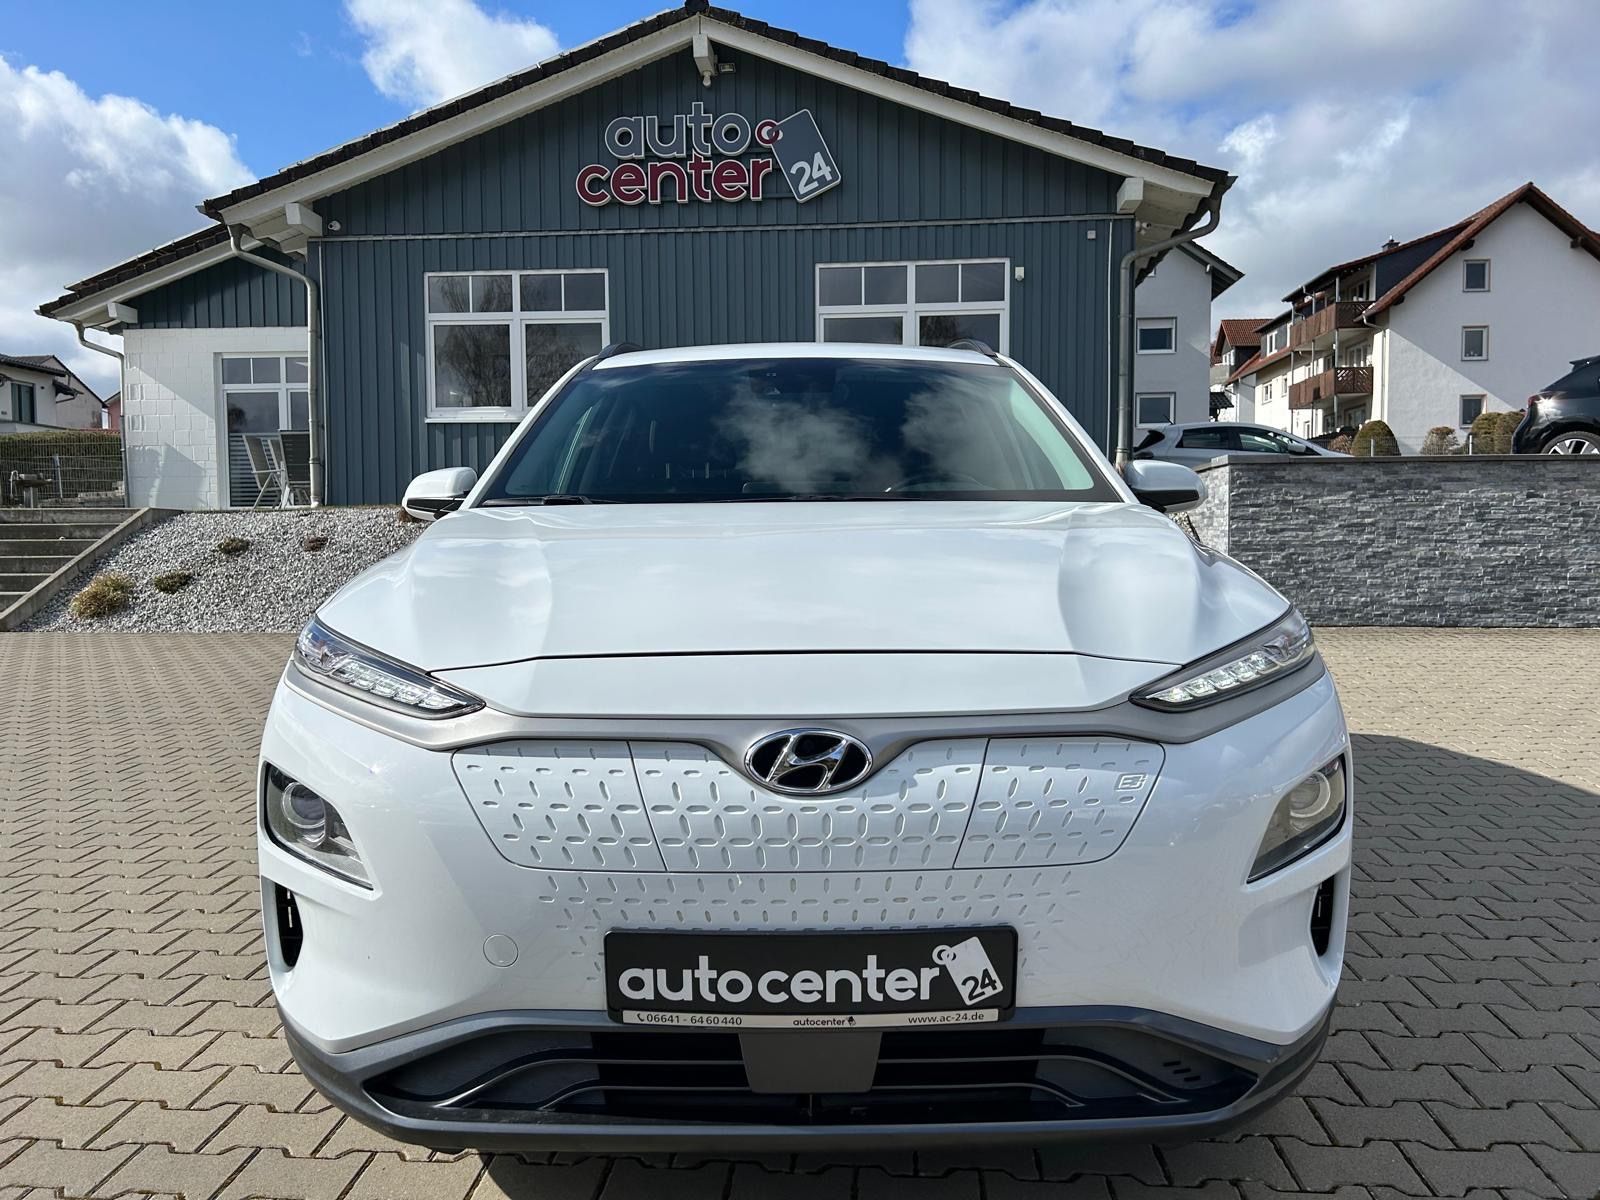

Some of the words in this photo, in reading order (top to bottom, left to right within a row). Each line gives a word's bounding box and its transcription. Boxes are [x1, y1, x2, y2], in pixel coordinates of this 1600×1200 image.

[604, 101, 751, 160] auto
[575, 149, 773, 207] center
[789, 151, 832, 195] 24
[961, 967, 998, 1002] 24
[793, 1016, 846, 1027] autocenter
[908, 1012, 985, 1024] www.ac-24.de
